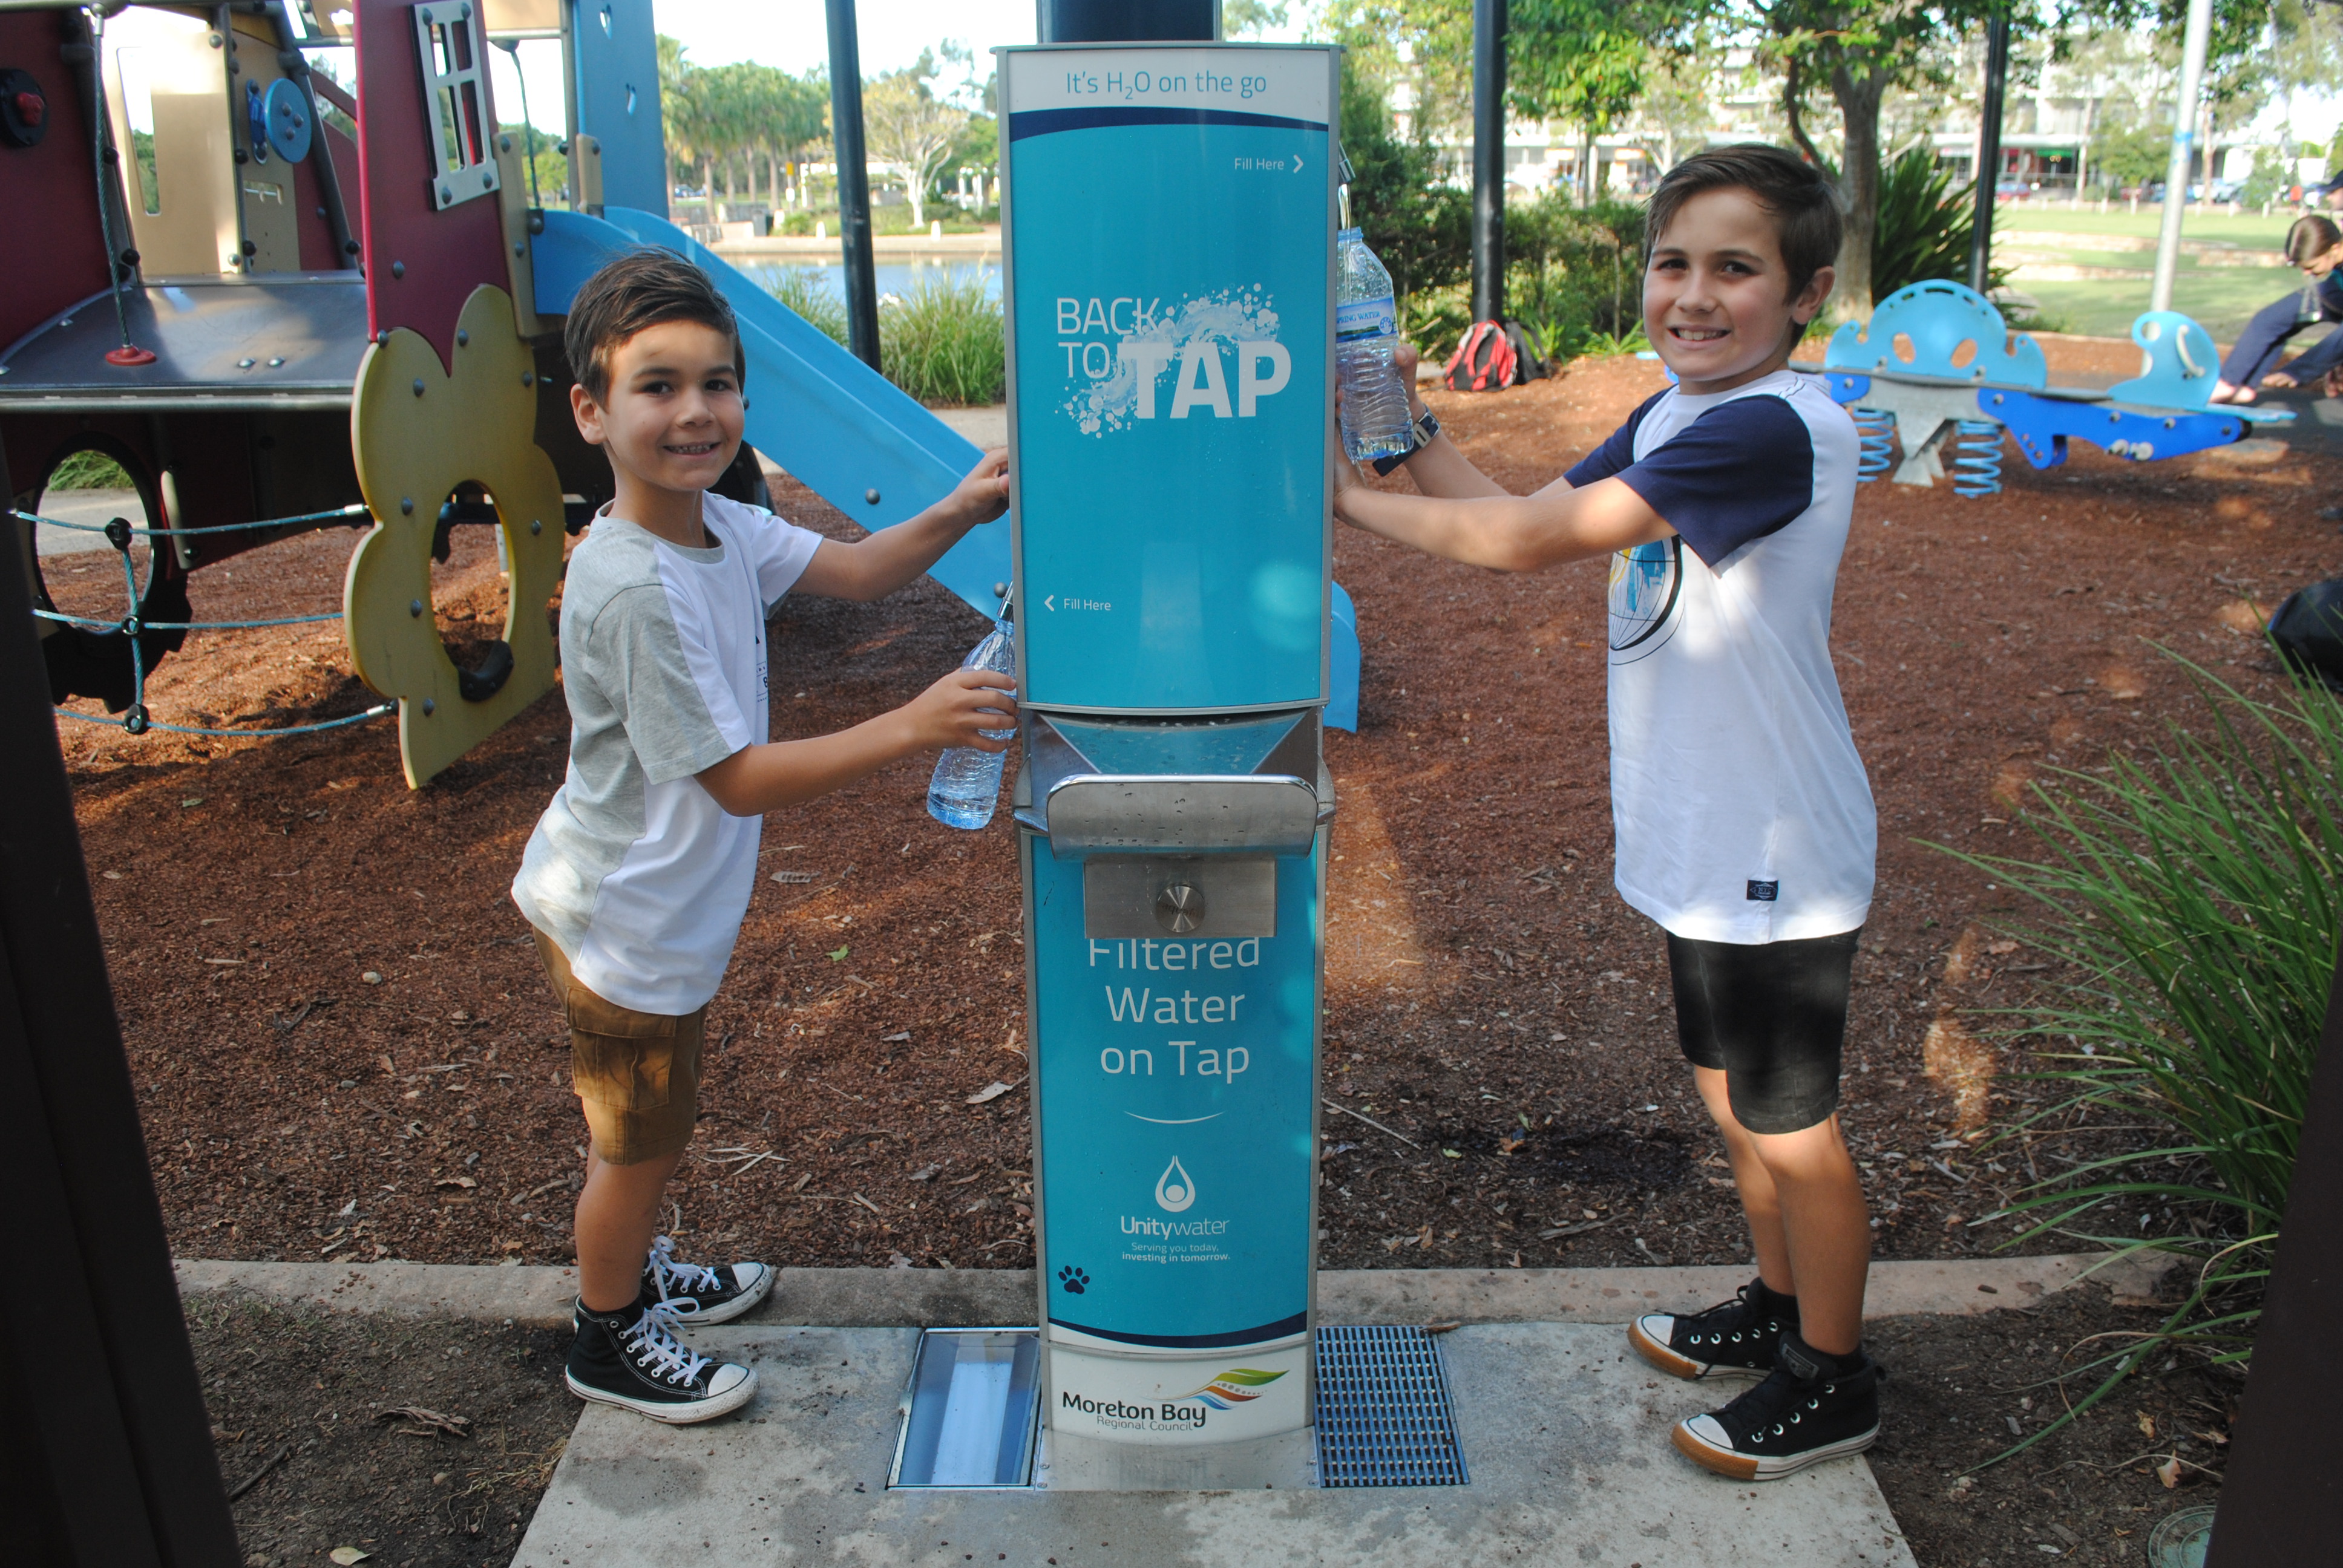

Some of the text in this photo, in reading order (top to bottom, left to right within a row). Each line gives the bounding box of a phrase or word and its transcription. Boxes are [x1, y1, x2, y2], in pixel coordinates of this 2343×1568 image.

[1067, 71, 1098, 94] It's
[1158, 76, 1187, 93] on
[1195, 70, 1233, 93] the
[1240, 76, 1267, 99] go
[1234, 157, 1284, 170] Fill Here
[1057, 297, 1161, 335] BACK
[1336, 313, 1357, 324] PRING
[1357, 311, 1380, 320] WATER
[1058, 340, 1292, 419] TO TAP
[1064, 598, 1112, 611] Fill Here
[1089, 937, 1259, 971] Filtered
[1105, 985, 1245, 1024] Water
[1101, 1040, 1250, 1084] on Tap
[1121, 1215, 1230, 1241] Unitywater
[1122, 1251, 1231, 1264] investing in tomorrow.
[1131, 1242, 1167, 1254] Serving
[1169, 1245, 1187, 1254] you
[1063, 1391, 1207, 1428] Moreton Bay
[1096, 1415, 1194, 1432] Regional Council
